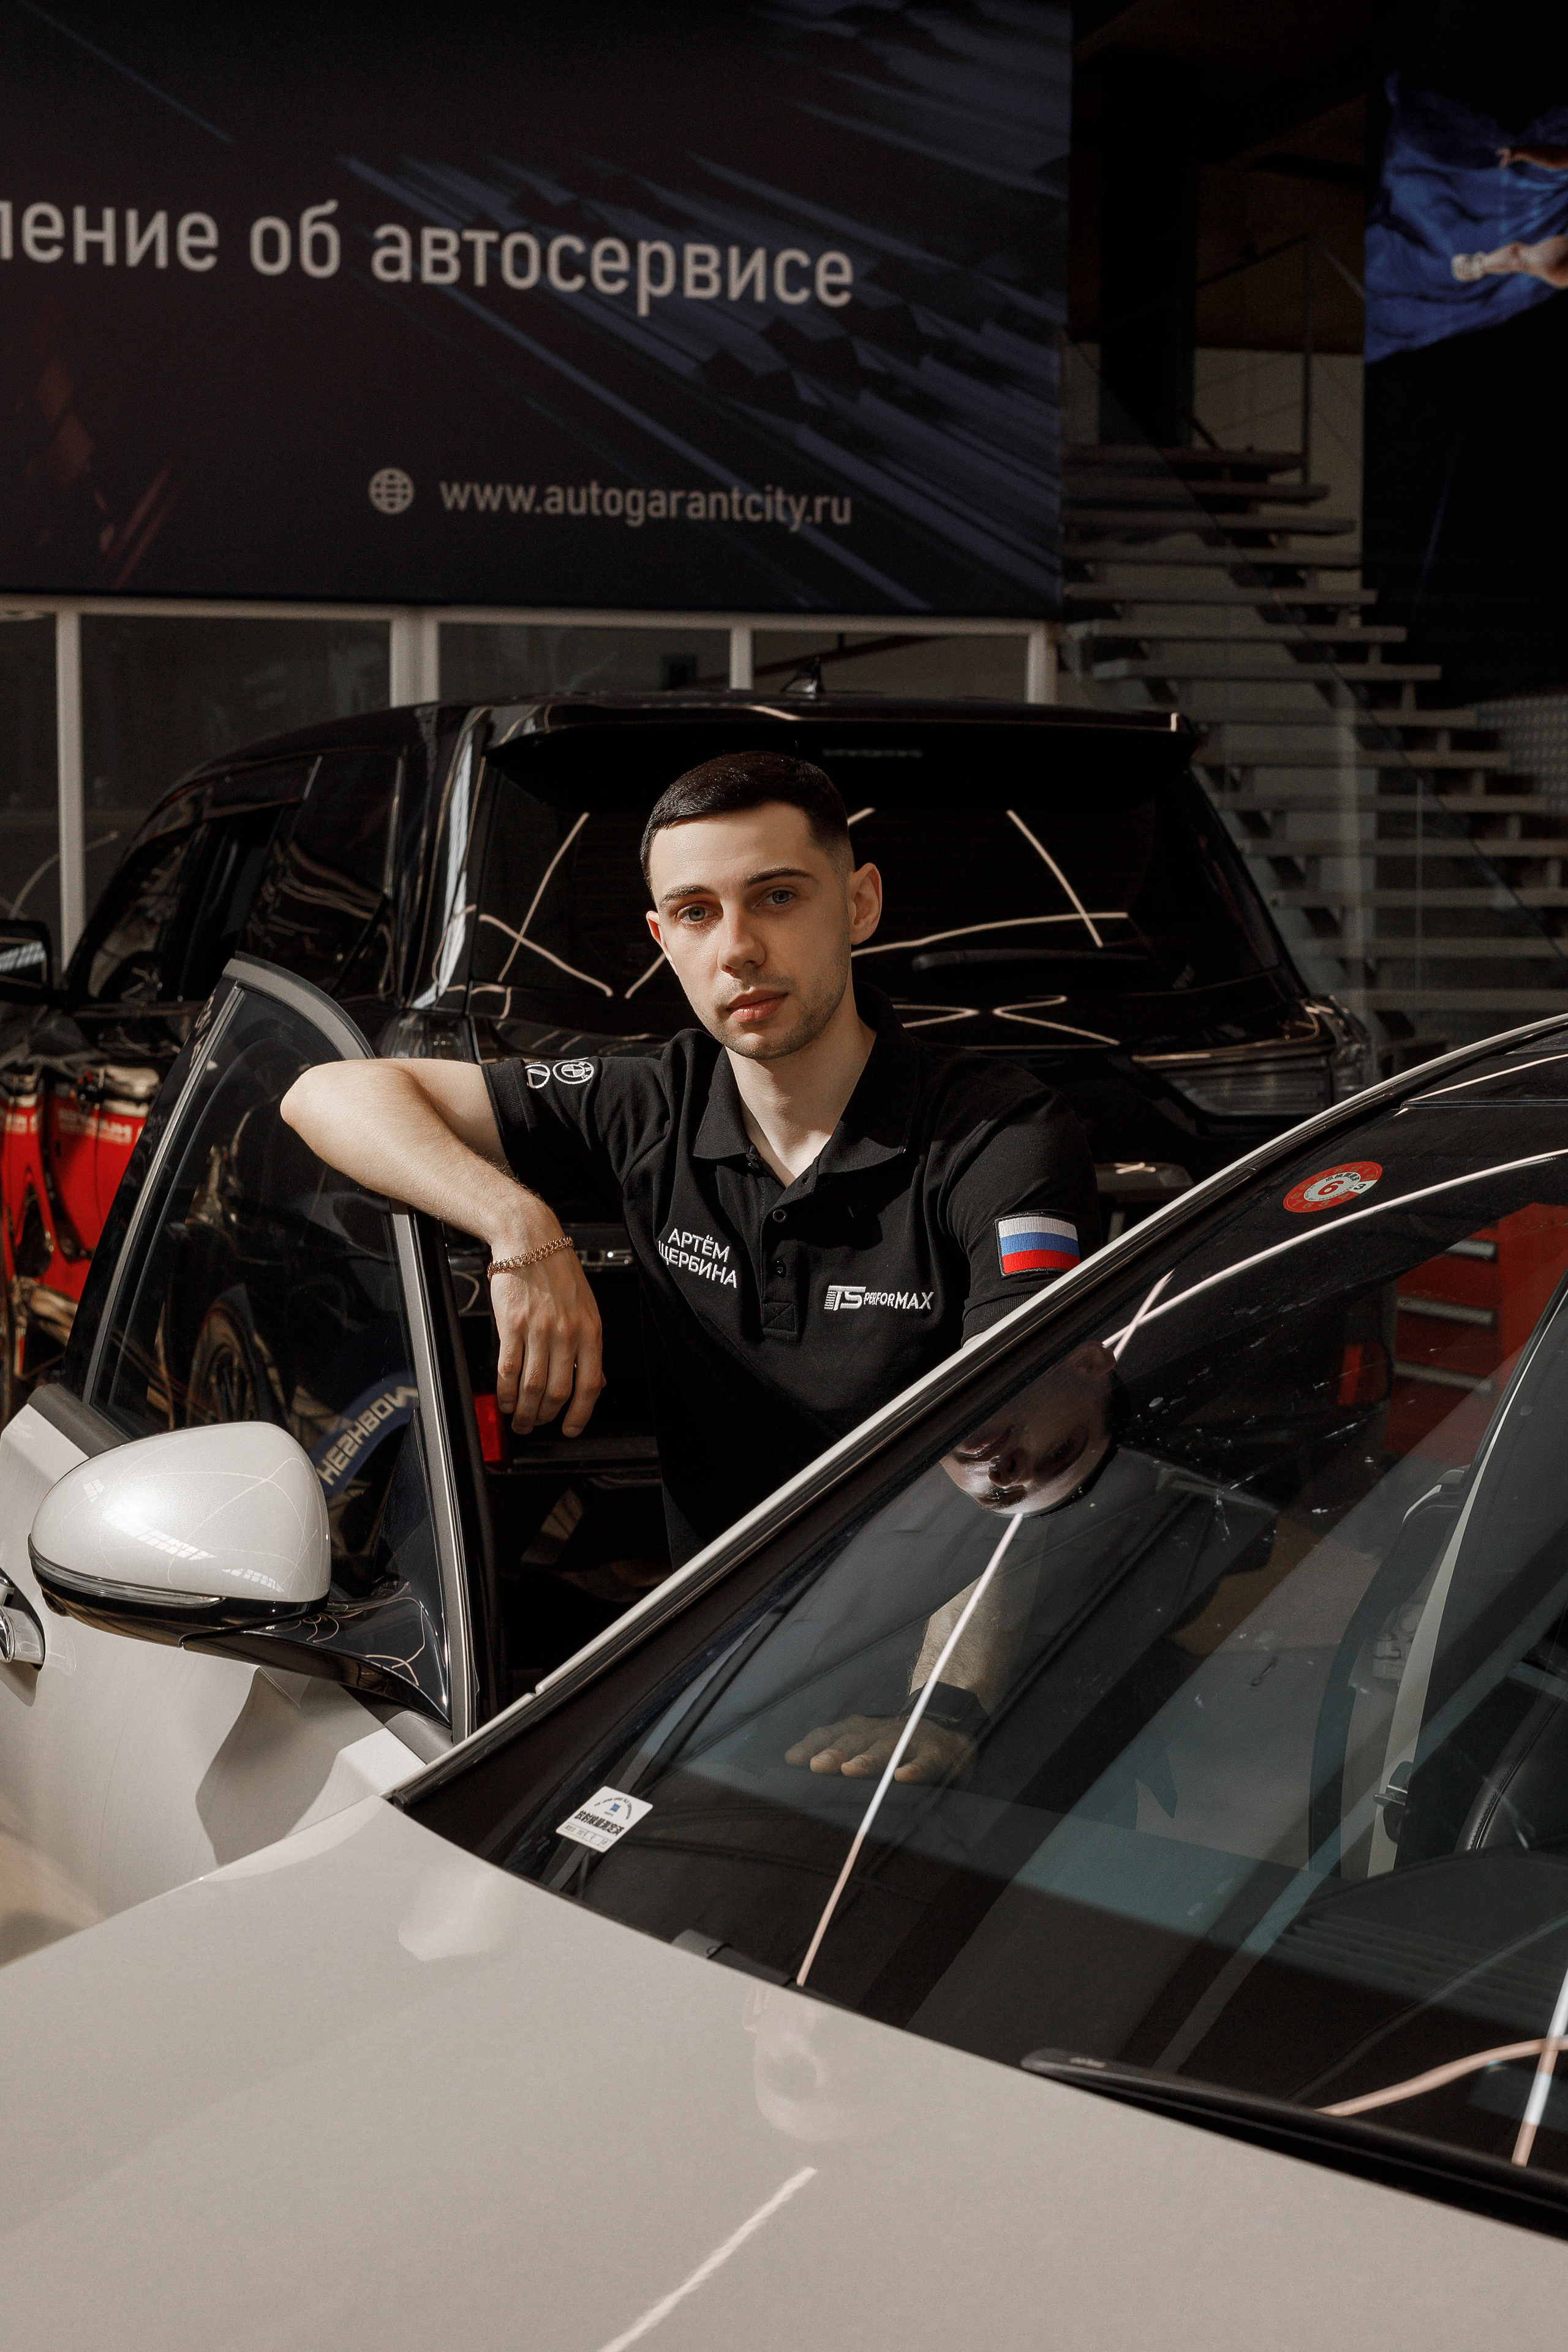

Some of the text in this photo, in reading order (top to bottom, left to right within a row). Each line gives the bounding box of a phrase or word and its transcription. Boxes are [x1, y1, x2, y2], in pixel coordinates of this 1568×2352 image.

[250, 199, 340, 278] об
[371, 224, 853, 317] автосервисе
[439, 480, 852, 532] www.autogarantcity.ru
[1317, 1180, 1344, 1195] 6
[658, 1240, 737, 1288] ЩЕРБИНА
[668, 1227, 730, 1262] АРТЁМ
